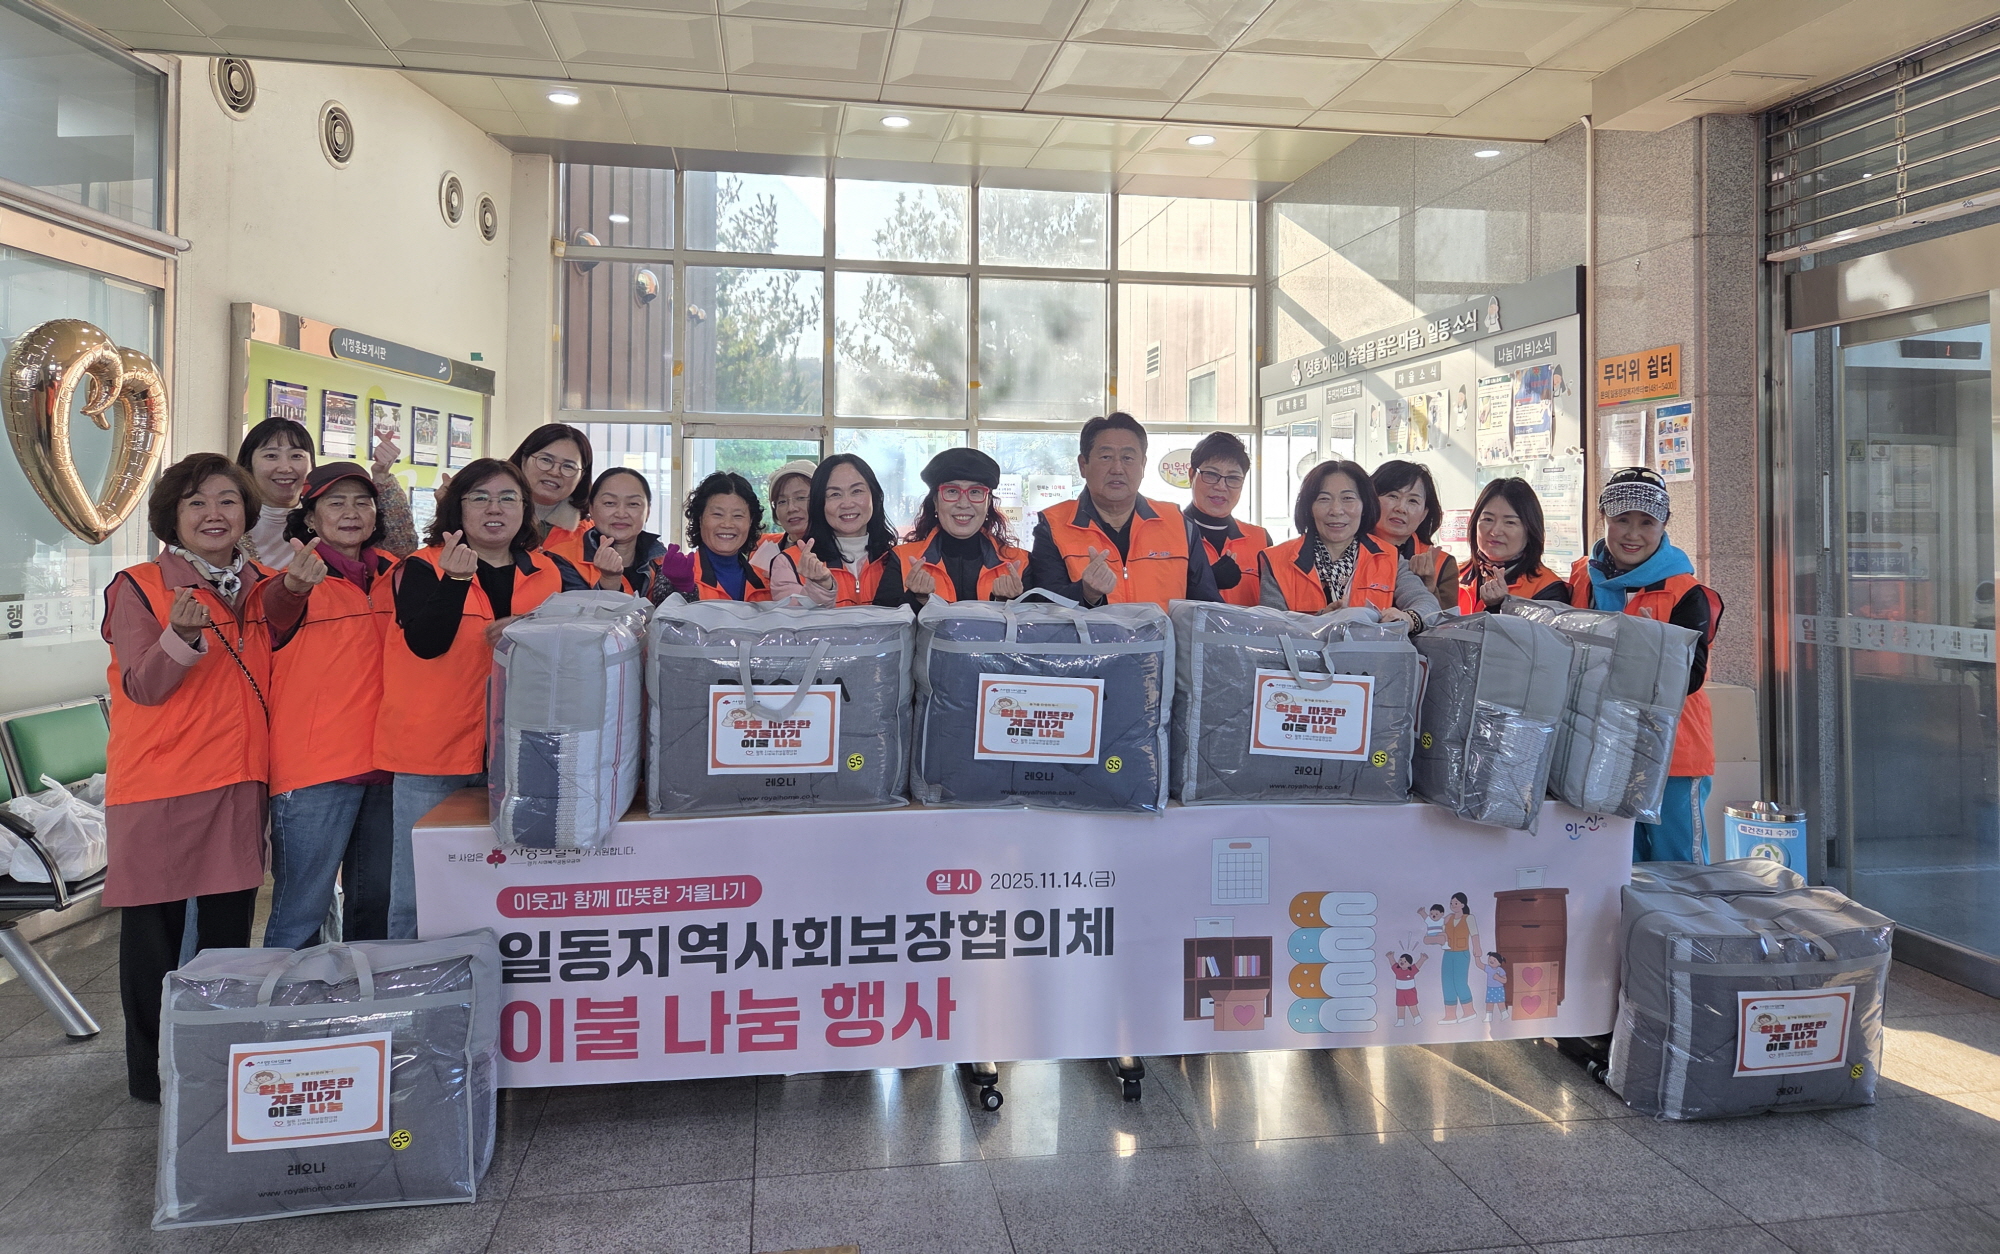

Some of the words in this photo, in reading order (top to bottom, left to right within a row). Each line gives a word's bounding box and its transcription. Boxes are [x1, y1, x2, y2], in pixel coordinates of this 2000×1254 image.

[341, 337, 387, 360] 시정홍보게시판
[1323, 351, 1348, 373] 이익의
[1349, 343, 1376, 366] 숨결을
[1378, 335, 1399, 359] 품은
[1428, 318, 1450, 343] 일동
[1453, 309, 1479, 335] 소식
[1498, 337, 1552, 363] 나눔(기부)소식
[1604, 358, 1640, 386] 무더위
[1647, 352, 1672, 379] 쉼터
[1871, 556, 1905, 567] 거리두기
[1422, 735, 1431, 747] SS
[849, 756, 862, 768] SS
[1107, 759, 1120, 770] SS
[1375, 753, 1386, 763] SS
[1024, 771, 1054, 781] 레오나
[1294, 766, 1323, 776] 레오나
[765, 777, 796, 788] 레오나
[1740, 825, 1773, 837] 폐건전지
[1776, 829, 1797, 837] 수거함
[448, 853, 456, 862] 본
[459, 853, 483, 863] 사업은
[990, 870, 1116, 890] 2025.11.14.(금)
[514, 891, 567, 911] 이웃과
[573, 889, 609, 909] 함께
[616, 886, 670, 907] 따뜻한
[676, 882, 746, 903] 겨울나기
[499, 907, 1114, 984] 일동지역사회보장협의체
[500, 996, 640, 1063] 이불
[664, 989, 801, 1054] 나눔
[821, 977, 956, 1048] 행사
[302, 1077, 354, 1092] 따뜻한
[1776, 1086, 1803, 1096] 레오나
[271, 1090, 341, 1106] 겨울나기
[268, 1104, 302, 1118] 이불
[309, 1101, 344, 1114] 나눔
[391, 1131, 410, 1148] SS
[287, 1162, 326, 1177] 레오나
[258, 1181, 357, 1199] www.royalhome.co.kr
